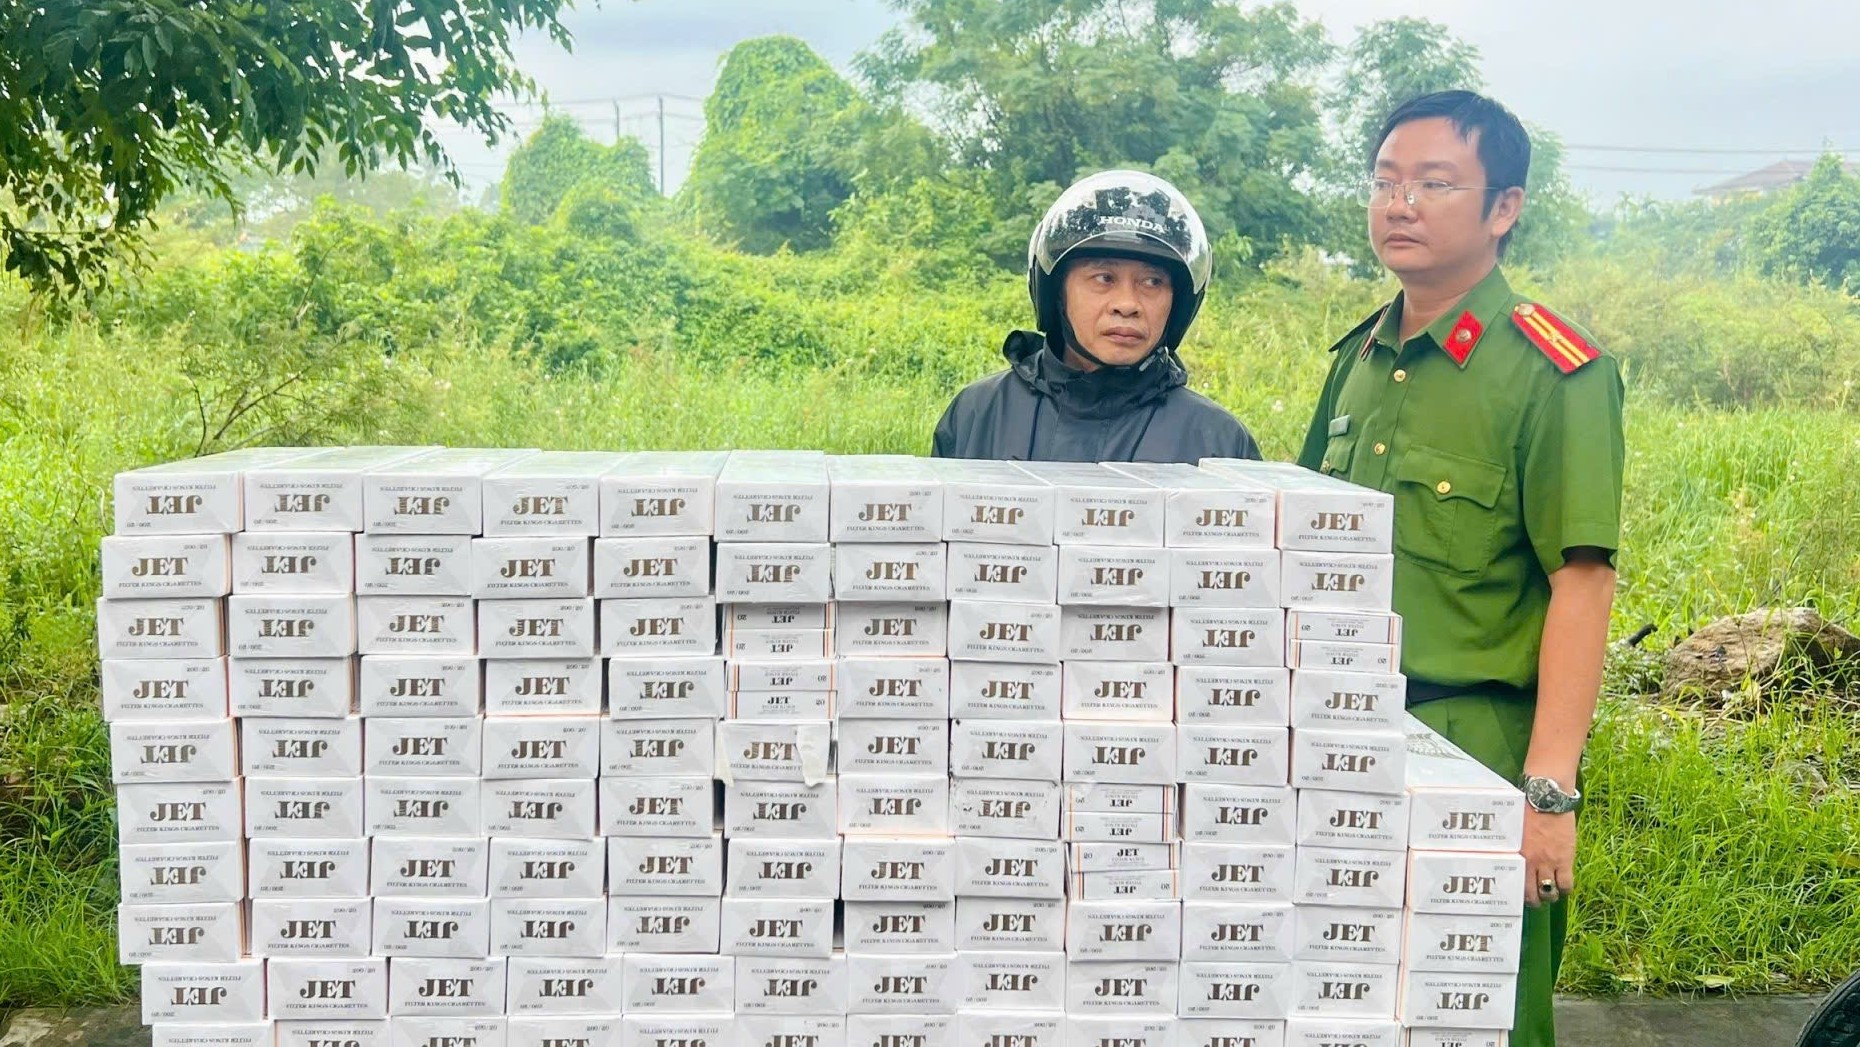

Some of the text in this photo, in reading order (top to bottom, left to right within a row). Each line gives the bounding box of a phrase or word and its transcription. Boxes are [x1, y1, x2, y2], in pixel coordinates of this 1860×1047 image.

[1099, 216, 1165, 233] HONDA
[146, 495, 202, 514] JET
[275, 494, 330, 512] JET
[394, 497, 449, 515] JET
[513, 496, 568, 515] JET
[631, 499, 685, 517] JET
[859, 503, 911, 521] JET
[747, 504, 800, 522] JET
[971, 506, 1023, 524] JET
[1082, 509, 1134, 527] JET
[1196, 510, 1248, 527] JET
[1311, 513, 1364, 531] JET
[132, 557, 188, 576] JET
[262, 556, 316, 574] JET
[386, 557, 440, 575] JET
[500, 559, 555, 578] JET
[624, 559, 677, 577] JET
[747, 564, 800, 583] JET
[866, 562, 919, 580] JET
[975, 564, 1027, 583] JET
[1091, 567, 1143, 585] JET
[1198, 571, 1250, 589] JET
[1312, 573, 1364, 591] JET
[128, 618, 184, 636] JET
[259, 619, 314, 637] JET
[389, 615, 444, 633] JET
[509, 618, 563, 637] JET
[630, 617, 684, 636] JET
[865, 619, 916, 636] JET
[980, 623, 1032, 641] JET
[1090, 624, 1142, 641] JET
[1203, 629, 1255, 648] JET
[770, 644, 793, 653] JET
[1331, 657, 1353, 665] JET
[133, 680, 188, 699] JET
[259, 679, 314, 698] JET
[390, 678, 445, 696] JET
[515, 677, 570, 695] JET
[640, 681, 694, 699] JET
[770, 677, 792, 685] JET
[869, 679, 922, 697] JET
[981, 681, 1034, 699] JET
[1094, 681, 1147, 699] JET
[1208, 688, 1260, 706] JET
[1325, 692, 1378, 711] JET
[141, 745, 196, 764] JET
[273, 740, 328, 758] JET
[392, 737, 447, 755] JET
[511, 740, 566, 759] JET
[630, 739, 684, 758] JET
[744, 742, 797, 760] JET
[868, 737, 920, 755] JET
[982, 742, 1035, 760] JET
[1092, 746, 1145, 765] JET
[1205, 748, 1258, 766] JET
[1322, 753, 1375, 772] JET
[150, 802, 206, 821] JET
[275, 801, 330, 819] JET
[394, 800, 448, 818] JET
[509, 801, 562, 819] JET
[629, 797, 683, 815] JET
[753, 803, 806, 821] JET
[869, 798, 921, 815] JET
[978, 800, 1031, 818] JET
[1215, 807, 1268, 825] JET
[1330, 810, 1382, 829] JET
[1442, 812, 1495, 830] JET
[280, 861, 335, 879] JET
[400, 859, 455, 878] JET
[520, 861, 575, 879] JET
[639, 856, 693, 874] JET
[758, 862, 812, 879] JET
[871, 862, 924, 879] JET
[985, 859, 1038, 877] JET
[1211, 864, 1264, 882] JET
[150, 866, 206, 885] JET
[1326, 869, 1379, 887] JET
[1114, 886, 1136, 894] JET
[1443, 876, 1495, 894] JET
[281, 920, 336, 939] JET
[404, 921, 458, 939] JET
[521, 921, 575, 938] JET
[636, 916, 690, 934] JET
[749, 920, 803, 938] JET
[873, 915, 925, 933] JET
[983, 914, 1035, 932] JET
[149, 927, 204, 945] JET
[1100, 924, 1152, 942] JET
[1211, 924, 1263, 942] JET
[1323, 923, 1375, 942] JET
[1440, 934, 1493, 952] JET
[300, 980, 355, 999] JET
[419, 979, 473, 997] JET
[539, 979, 593, 997] JET
[652, 977, 705, 995] JET
[764, 979, 817, 997] JET
[874, 976, 927, 994] JET
[985, 974, 1038, 991] JET
[1095, 979, 1147, 997] JET
[1318, 982, 1370, 999] JET
[171, 987, 227, 1006] JET
[1207, 983, 1260, 1001] JET
[1437, 992, 1489, 1010] JET
